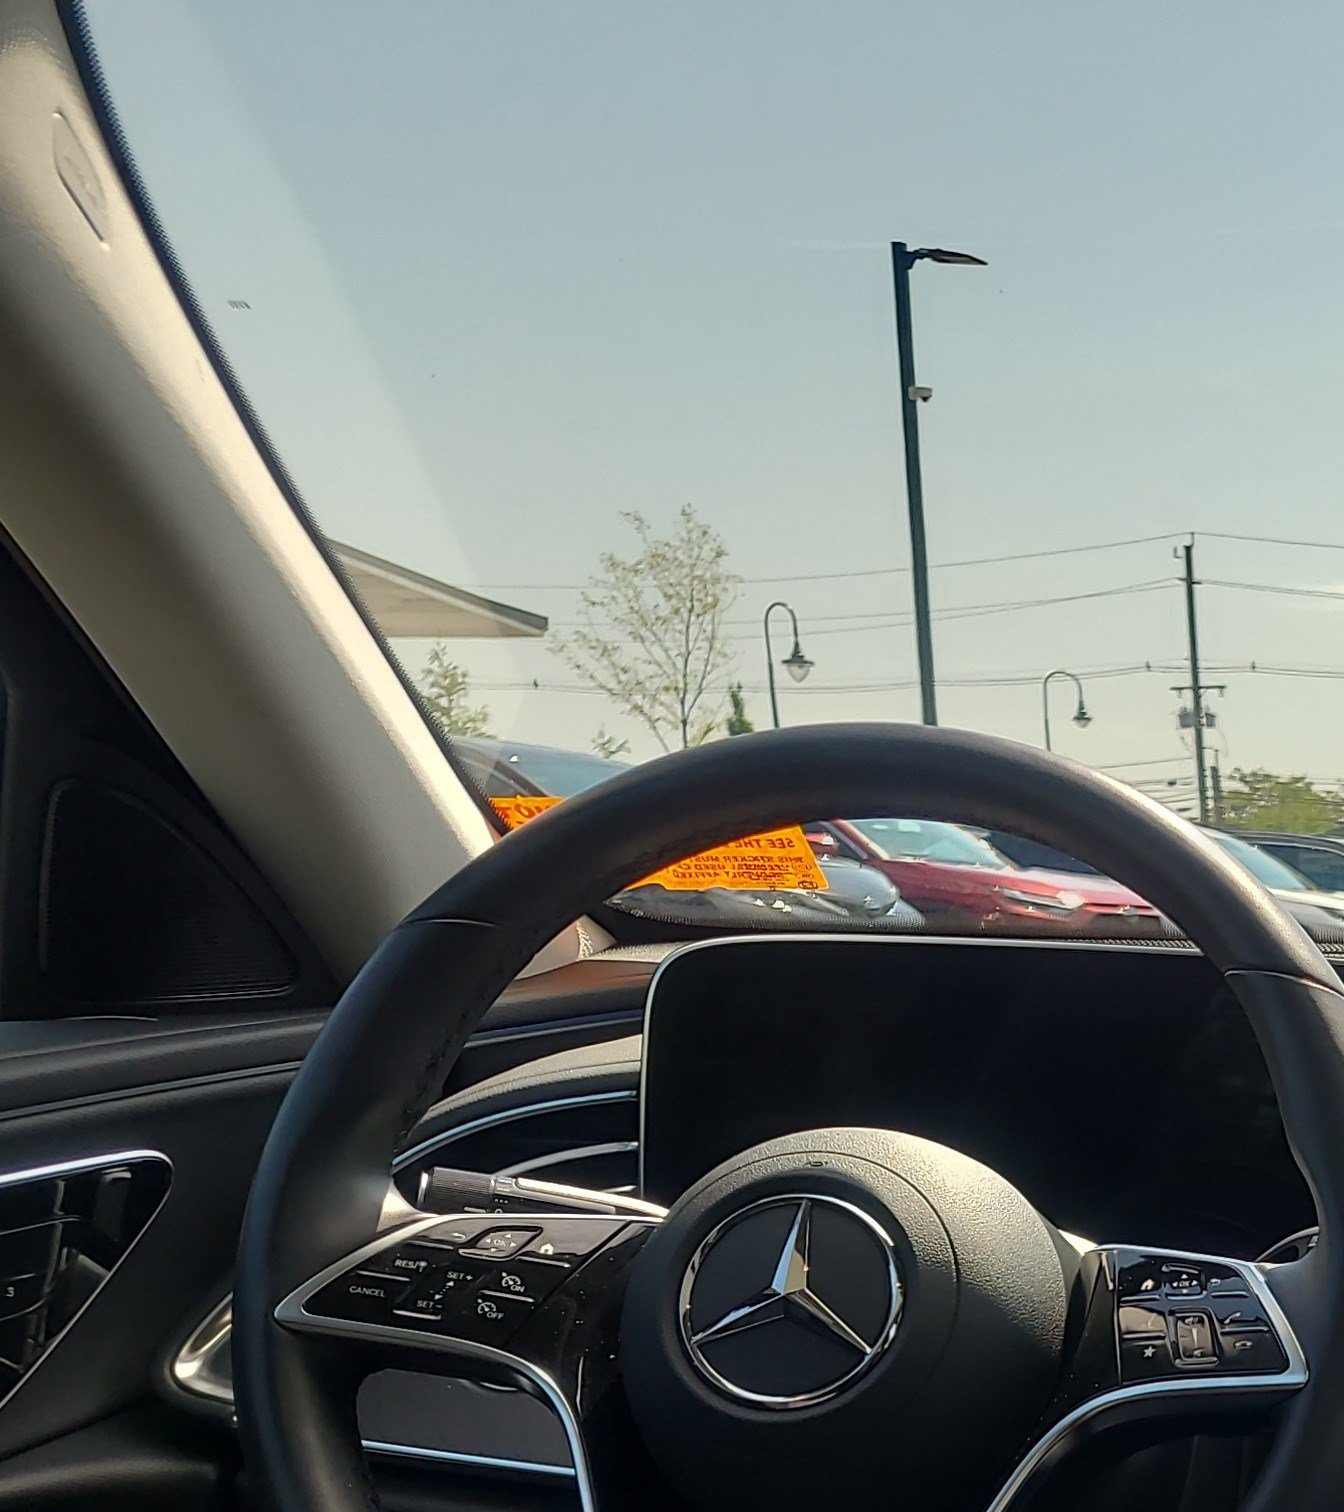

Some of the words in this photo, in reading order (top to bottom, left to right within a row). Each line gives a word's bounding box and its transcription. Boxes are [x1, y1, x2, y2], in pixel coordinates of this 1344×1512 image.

[494, 1237, 508, 1247] OK
[349, 1285, 385, 1298] CANCEL
[510, 1284, 526, 1293] ON
[486, 1311, 505, 1319] OFF
